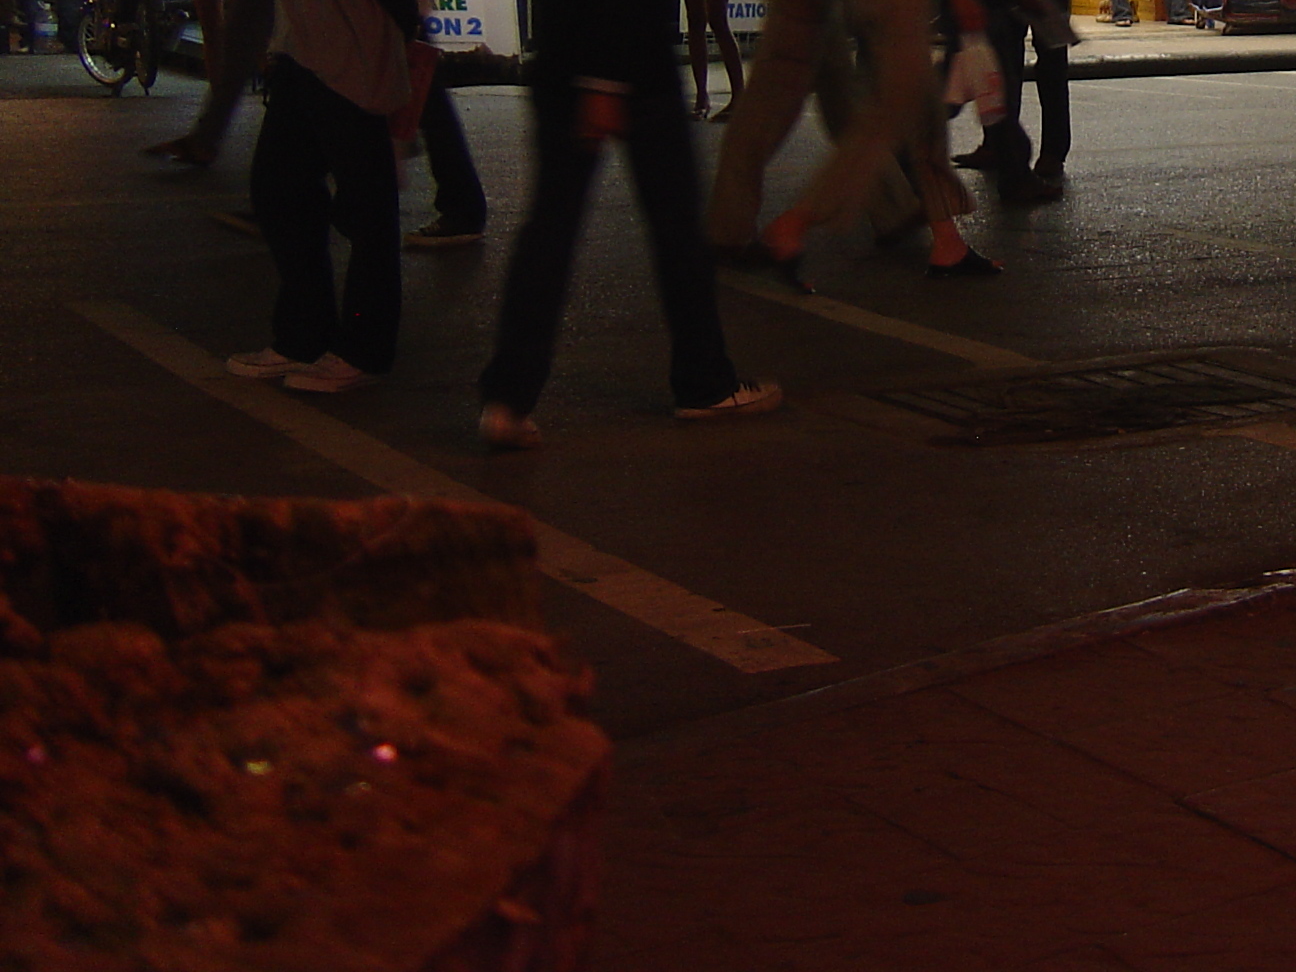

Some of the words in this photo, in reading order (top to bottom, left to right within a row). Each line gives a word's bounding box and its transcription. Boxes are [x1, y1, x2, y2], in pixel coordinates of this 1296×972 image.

[727, 2, 767, 18] TATIO
[424, 16, 463, 36] ON
[467, 17, 483, 36] 2
